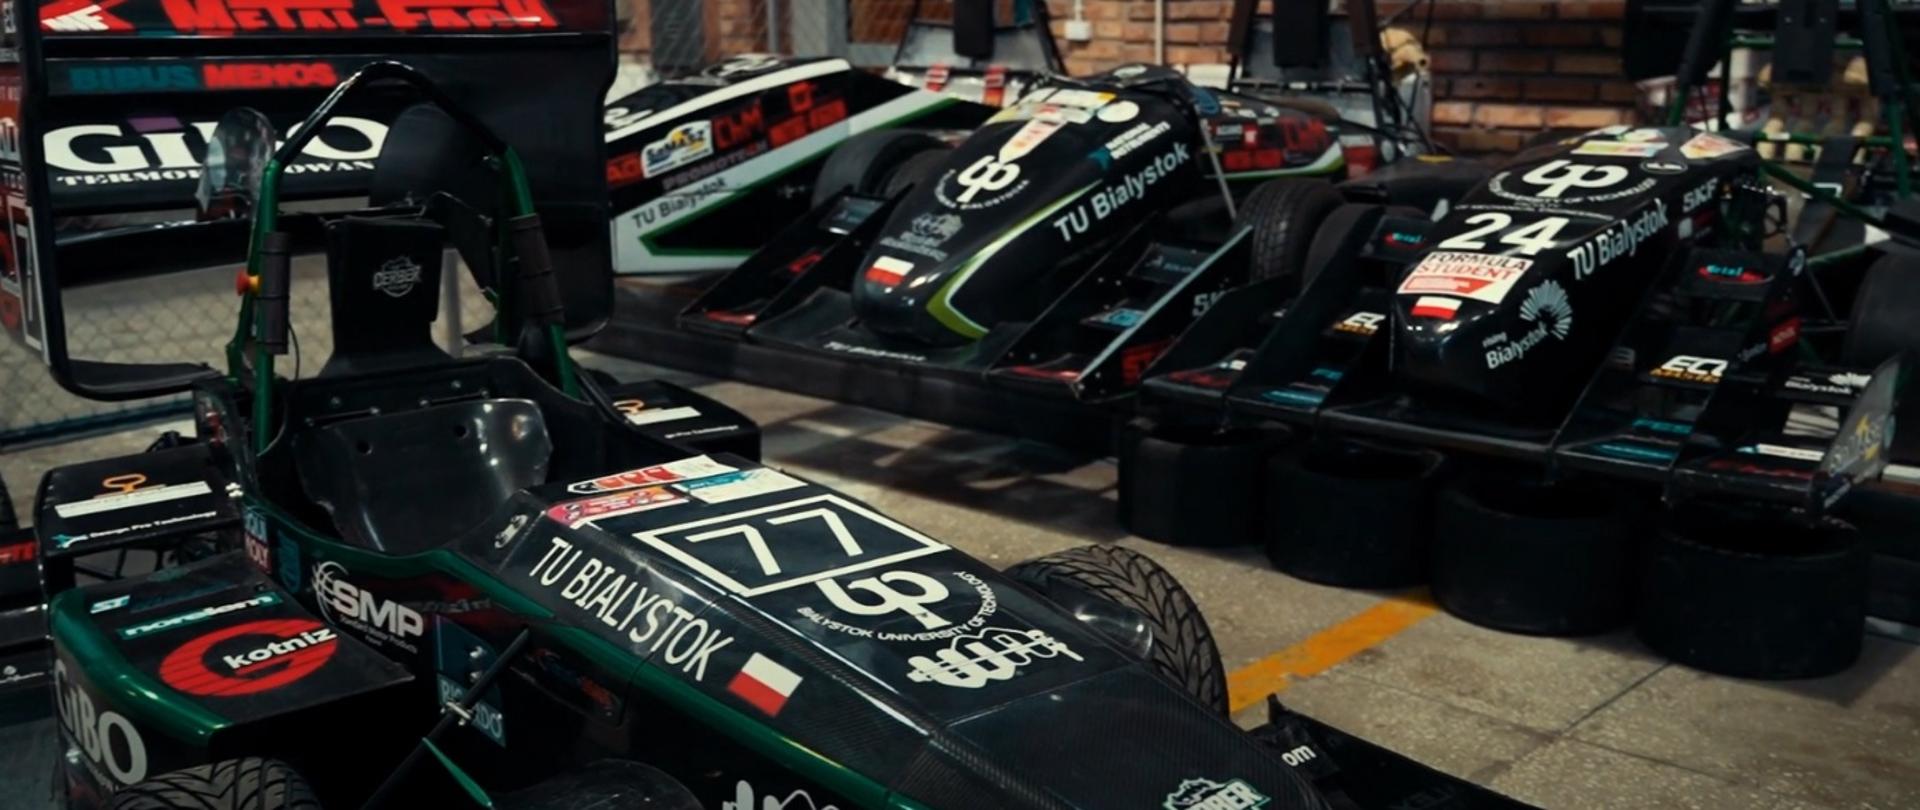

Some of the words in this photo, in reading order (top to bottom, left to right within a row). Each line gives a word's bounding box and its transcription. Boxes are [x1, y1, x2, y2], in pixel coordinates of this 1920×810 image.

[68, 64, 198, 91] BIBUS
[632, 211, 656, 229] TU
[660, 178, 727, 217] Bialystok
[1053, 204, 1091, 242] TU
[1092, 141, 1191, 224] Bialystok
[1683, 176, 1720, 214] SKF
[1437, 211, 1571, 257] 24
[1566, 248, 1597, 281] TU
[1598, 198, 1670, 267] Bialystok
[1417, 263, 1517, 281] STUDENT
[1428, 253, 1528, 271] FORMULA
[1484, 320, 1548, 370] Bialystok
[685, 504, 864, 577] 77
[330, 579, 424, 638] SMP
[529, 537, 578, 587] TU
[562, 555, 735, 682] BIALYSTOK
[797, 606, 875, 639] BIALYSTOK
[876, 623, 973, 642] UNIVERSITY
[952, 570, 999, 623] TECHNOLOGY
[222, 627, 339, 671] kotniz
